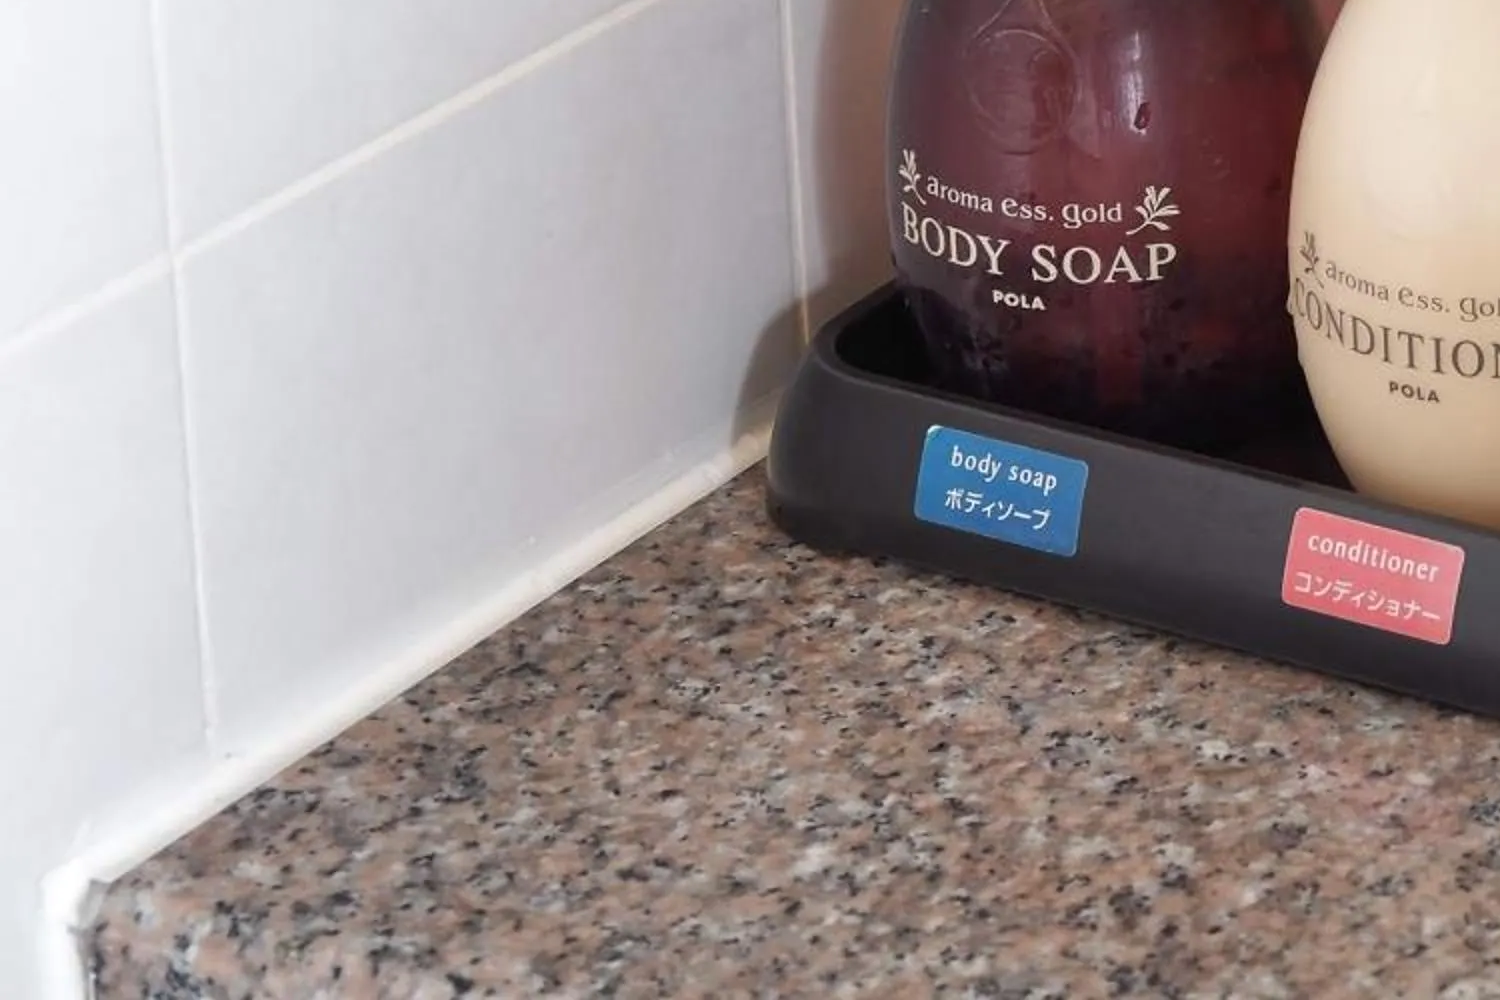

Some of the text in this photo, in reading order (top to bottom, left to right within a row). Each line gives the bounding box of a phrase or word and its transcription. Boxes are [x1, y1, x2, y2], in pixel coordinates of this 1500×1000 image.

[926, 174, 1123, 229] aroma ess. gold
[901, 201, 1178, 284] BODY SOAP
[992, 289, 1047, 311] POLA
[1325, 260, 1389, 302] aroma
[1397, 285, 1450, 314] ess.
[1389, 380, 1441, 404] POLA
[951, 445, 1057, 496] body soap
[1308, 535, 1439, 582] conditioner
[1294, 571, 1441, 620] コンディショナー
